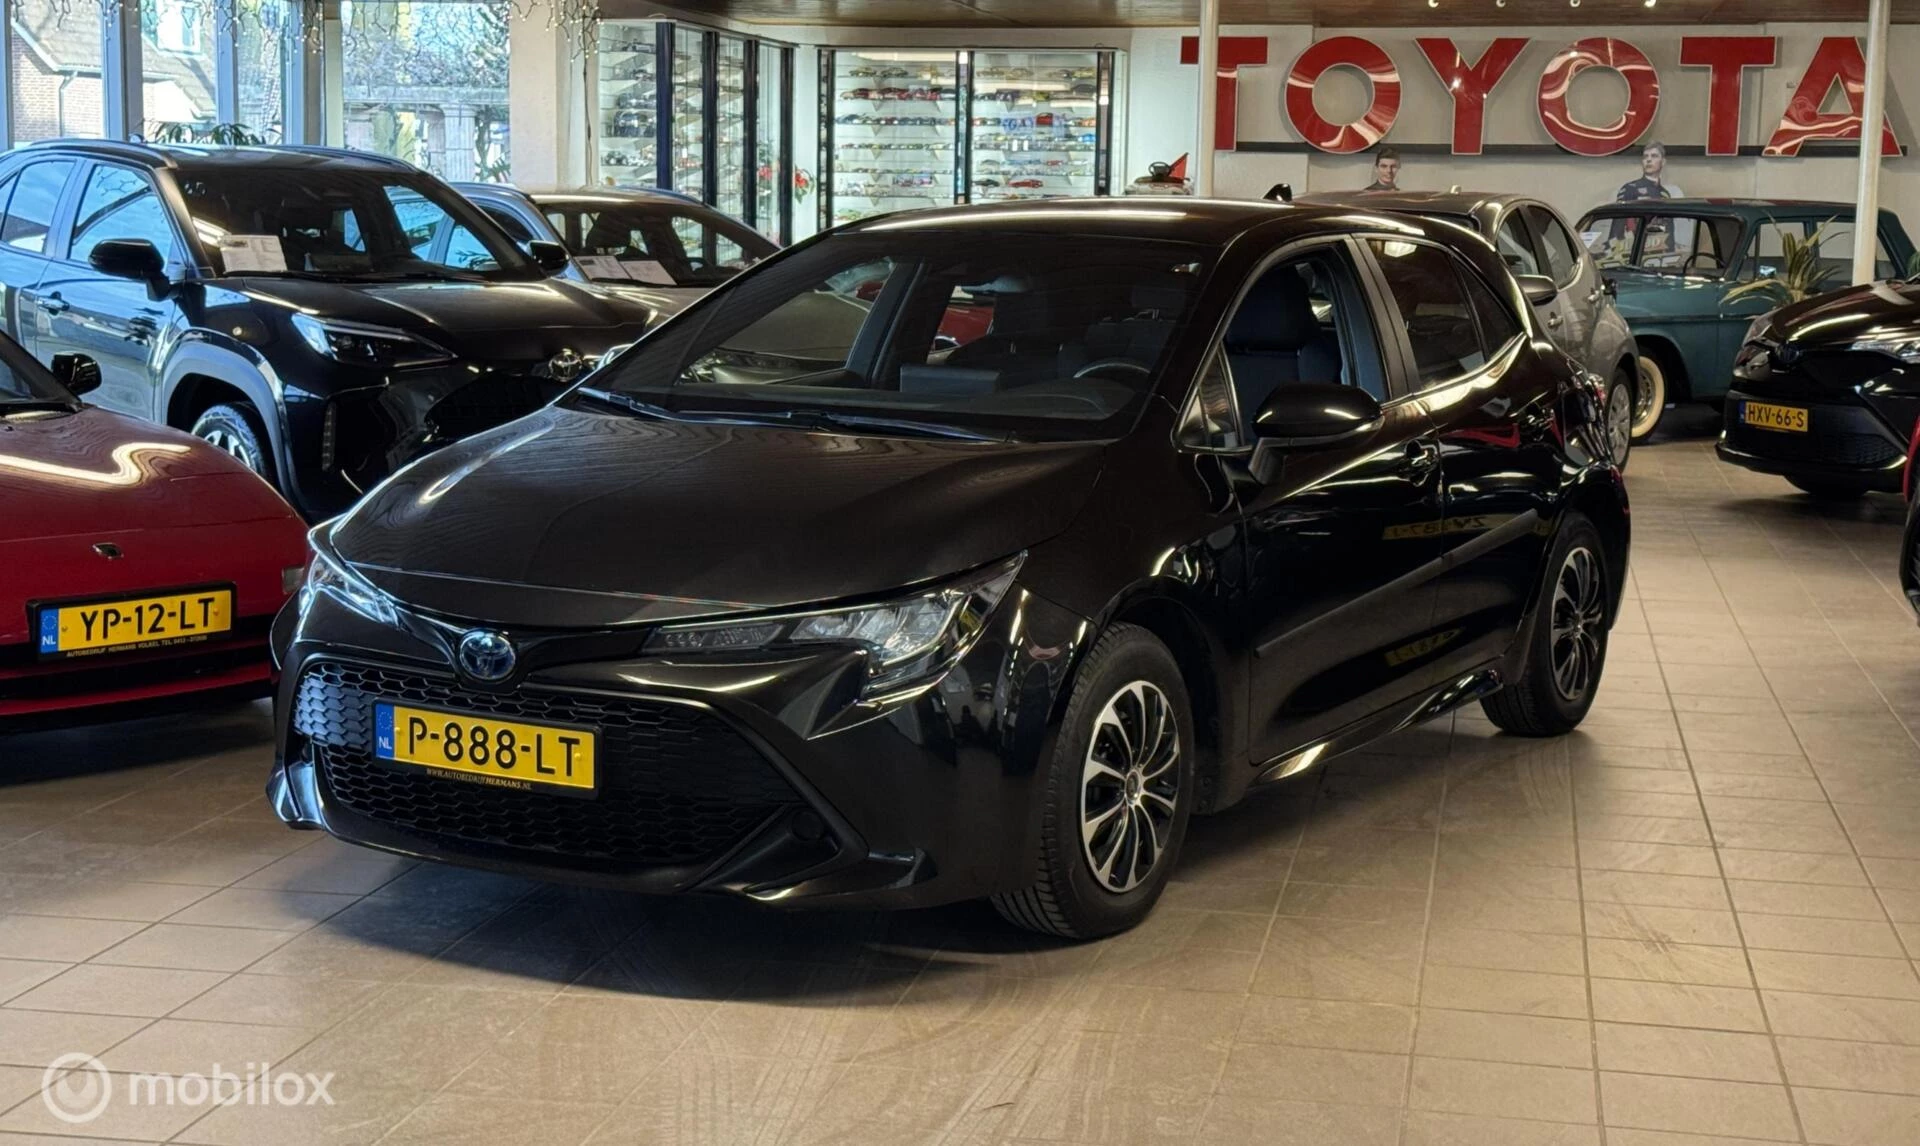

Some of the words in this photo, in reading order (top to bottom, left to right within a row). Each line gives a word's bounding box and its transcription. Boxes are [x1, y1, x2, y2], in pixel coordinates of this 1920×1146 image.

[1180, 35, 1903, 157] TOYOTA
[1748, 404, 1804, 428] HXV-66-S
[80, 597, 215, 642] YP-12-LT
[42, 635, 57, 646] NL
[378, 736, 392, 750] NL
[408, 716, 580, 777] P-888-LT
